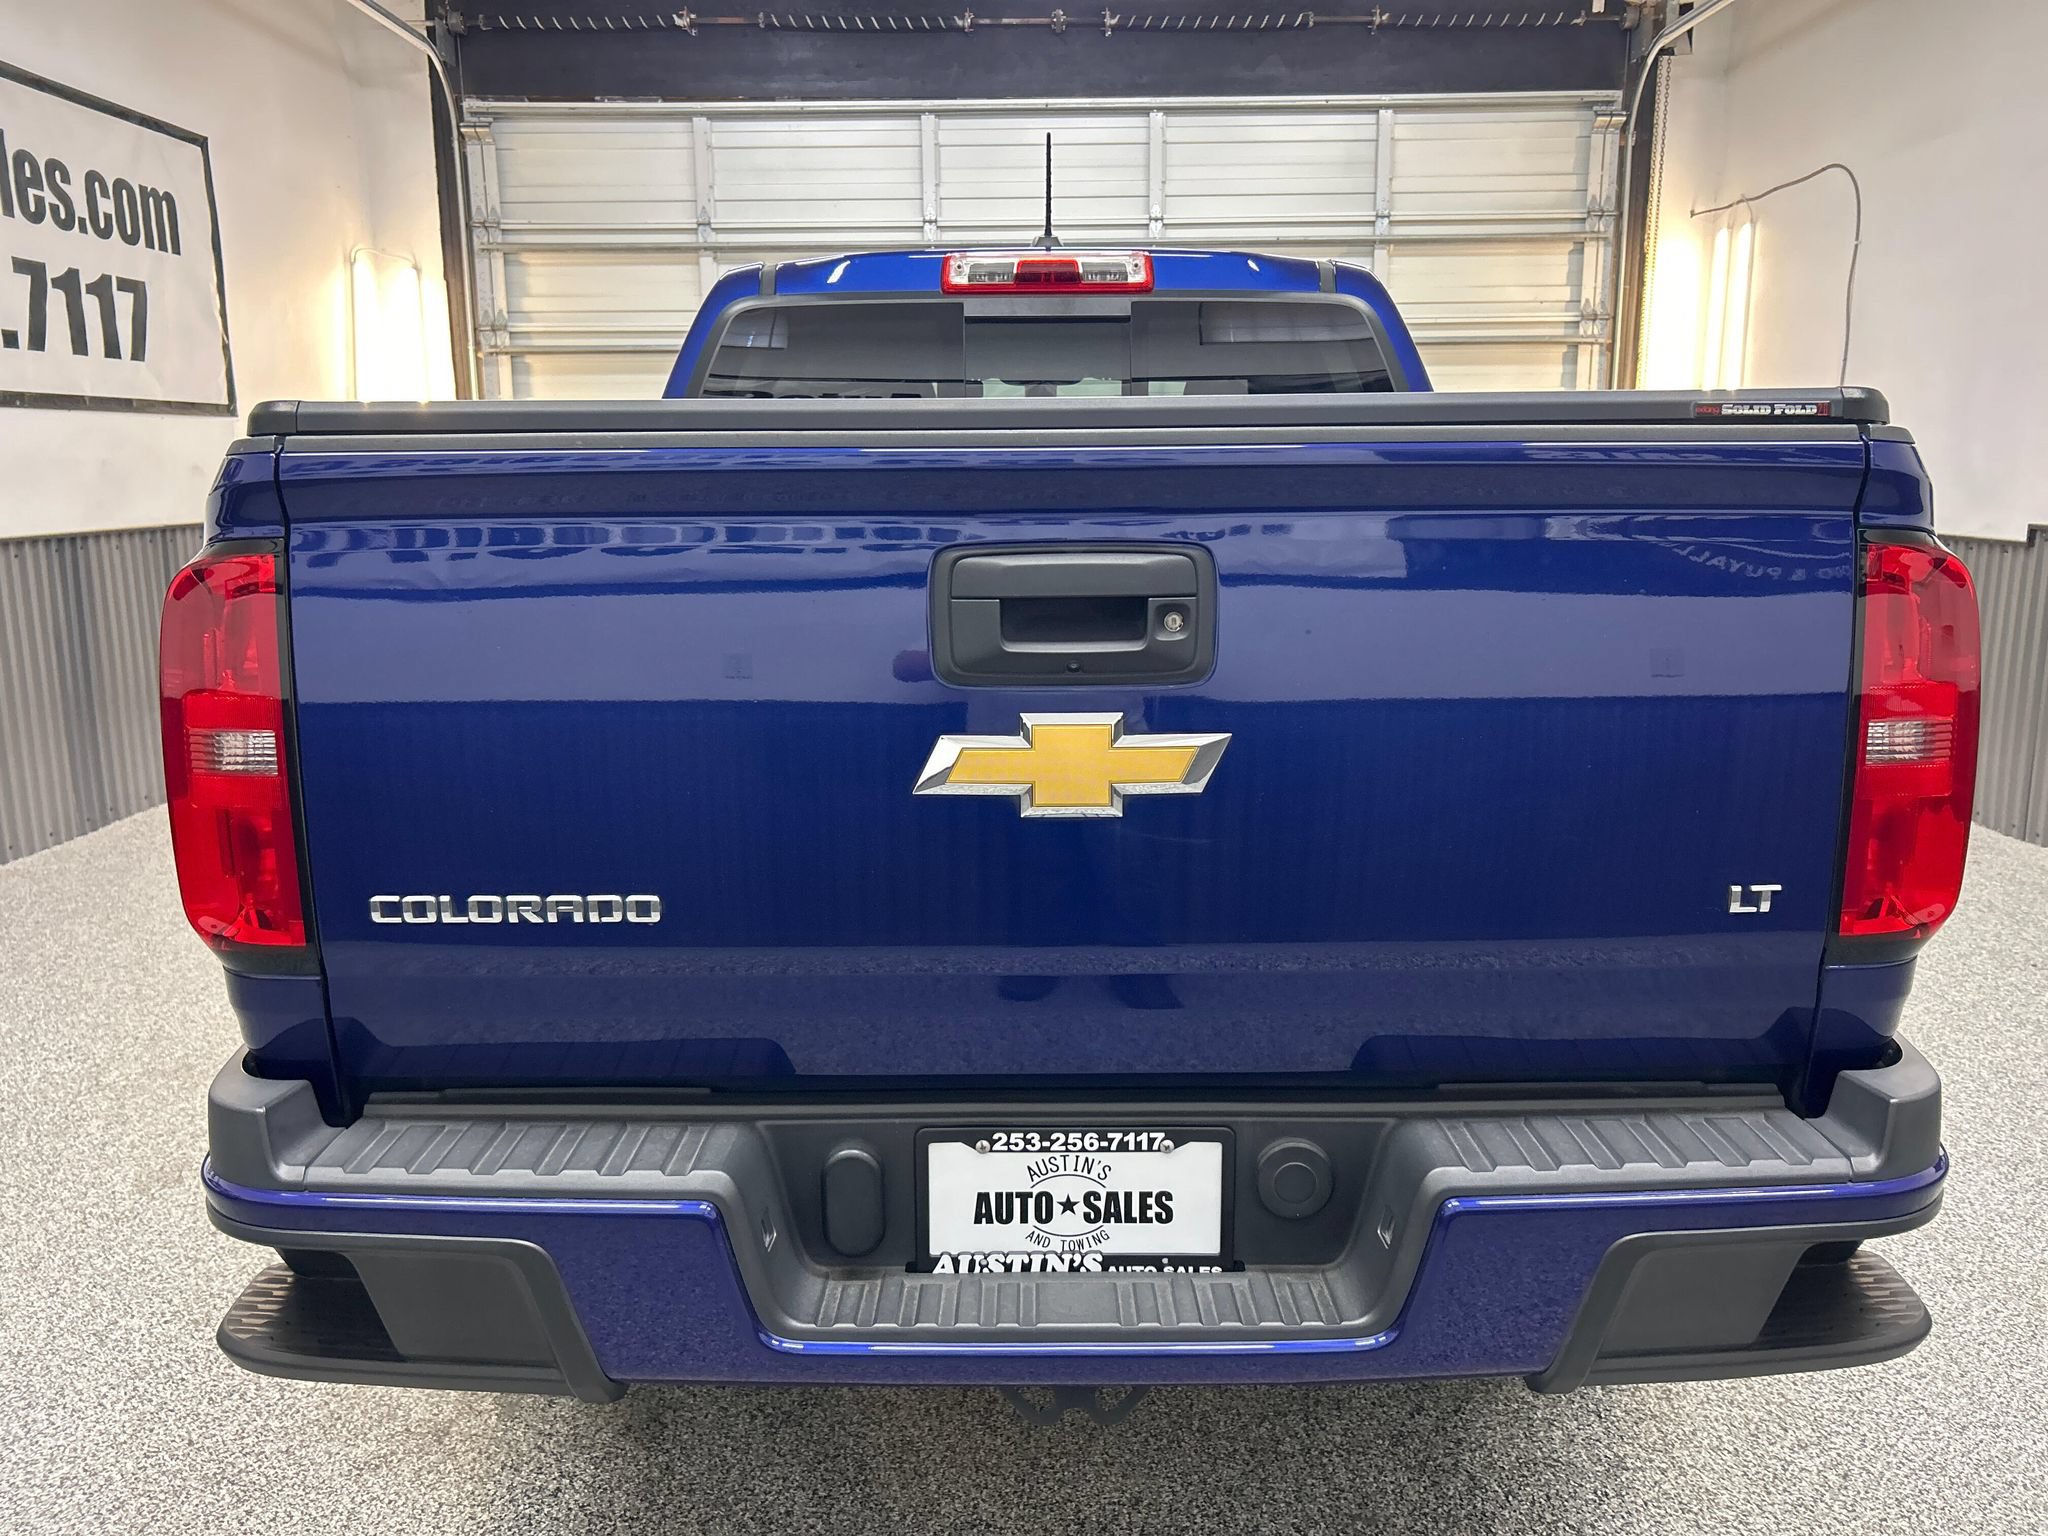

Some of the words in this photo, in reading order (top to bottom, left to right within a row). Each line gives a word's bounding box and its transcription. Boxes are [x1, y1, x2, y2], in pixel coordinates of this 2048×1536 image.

[1721, 403, 1771, 416] SOLID
[1773, 403, 1817, 416] FOLD
[369, 894, 661, 924] COLORADO
[1729, 884, 1782, 913] LT
[992, 1132, 1166, 1152] 253-256-7117
[1025, 1155, 1112, 1182] AUSTIN'S
[973, 1190, 1054, 1225] AUTO
[1082, 1190, 1174, 1225] SALES
[1025, 1230, 1051, 1249] AND
[1060, 1229, 1111, 1252] TOWING
[932, 1252, 1104, 1273] AUSTIN'S
